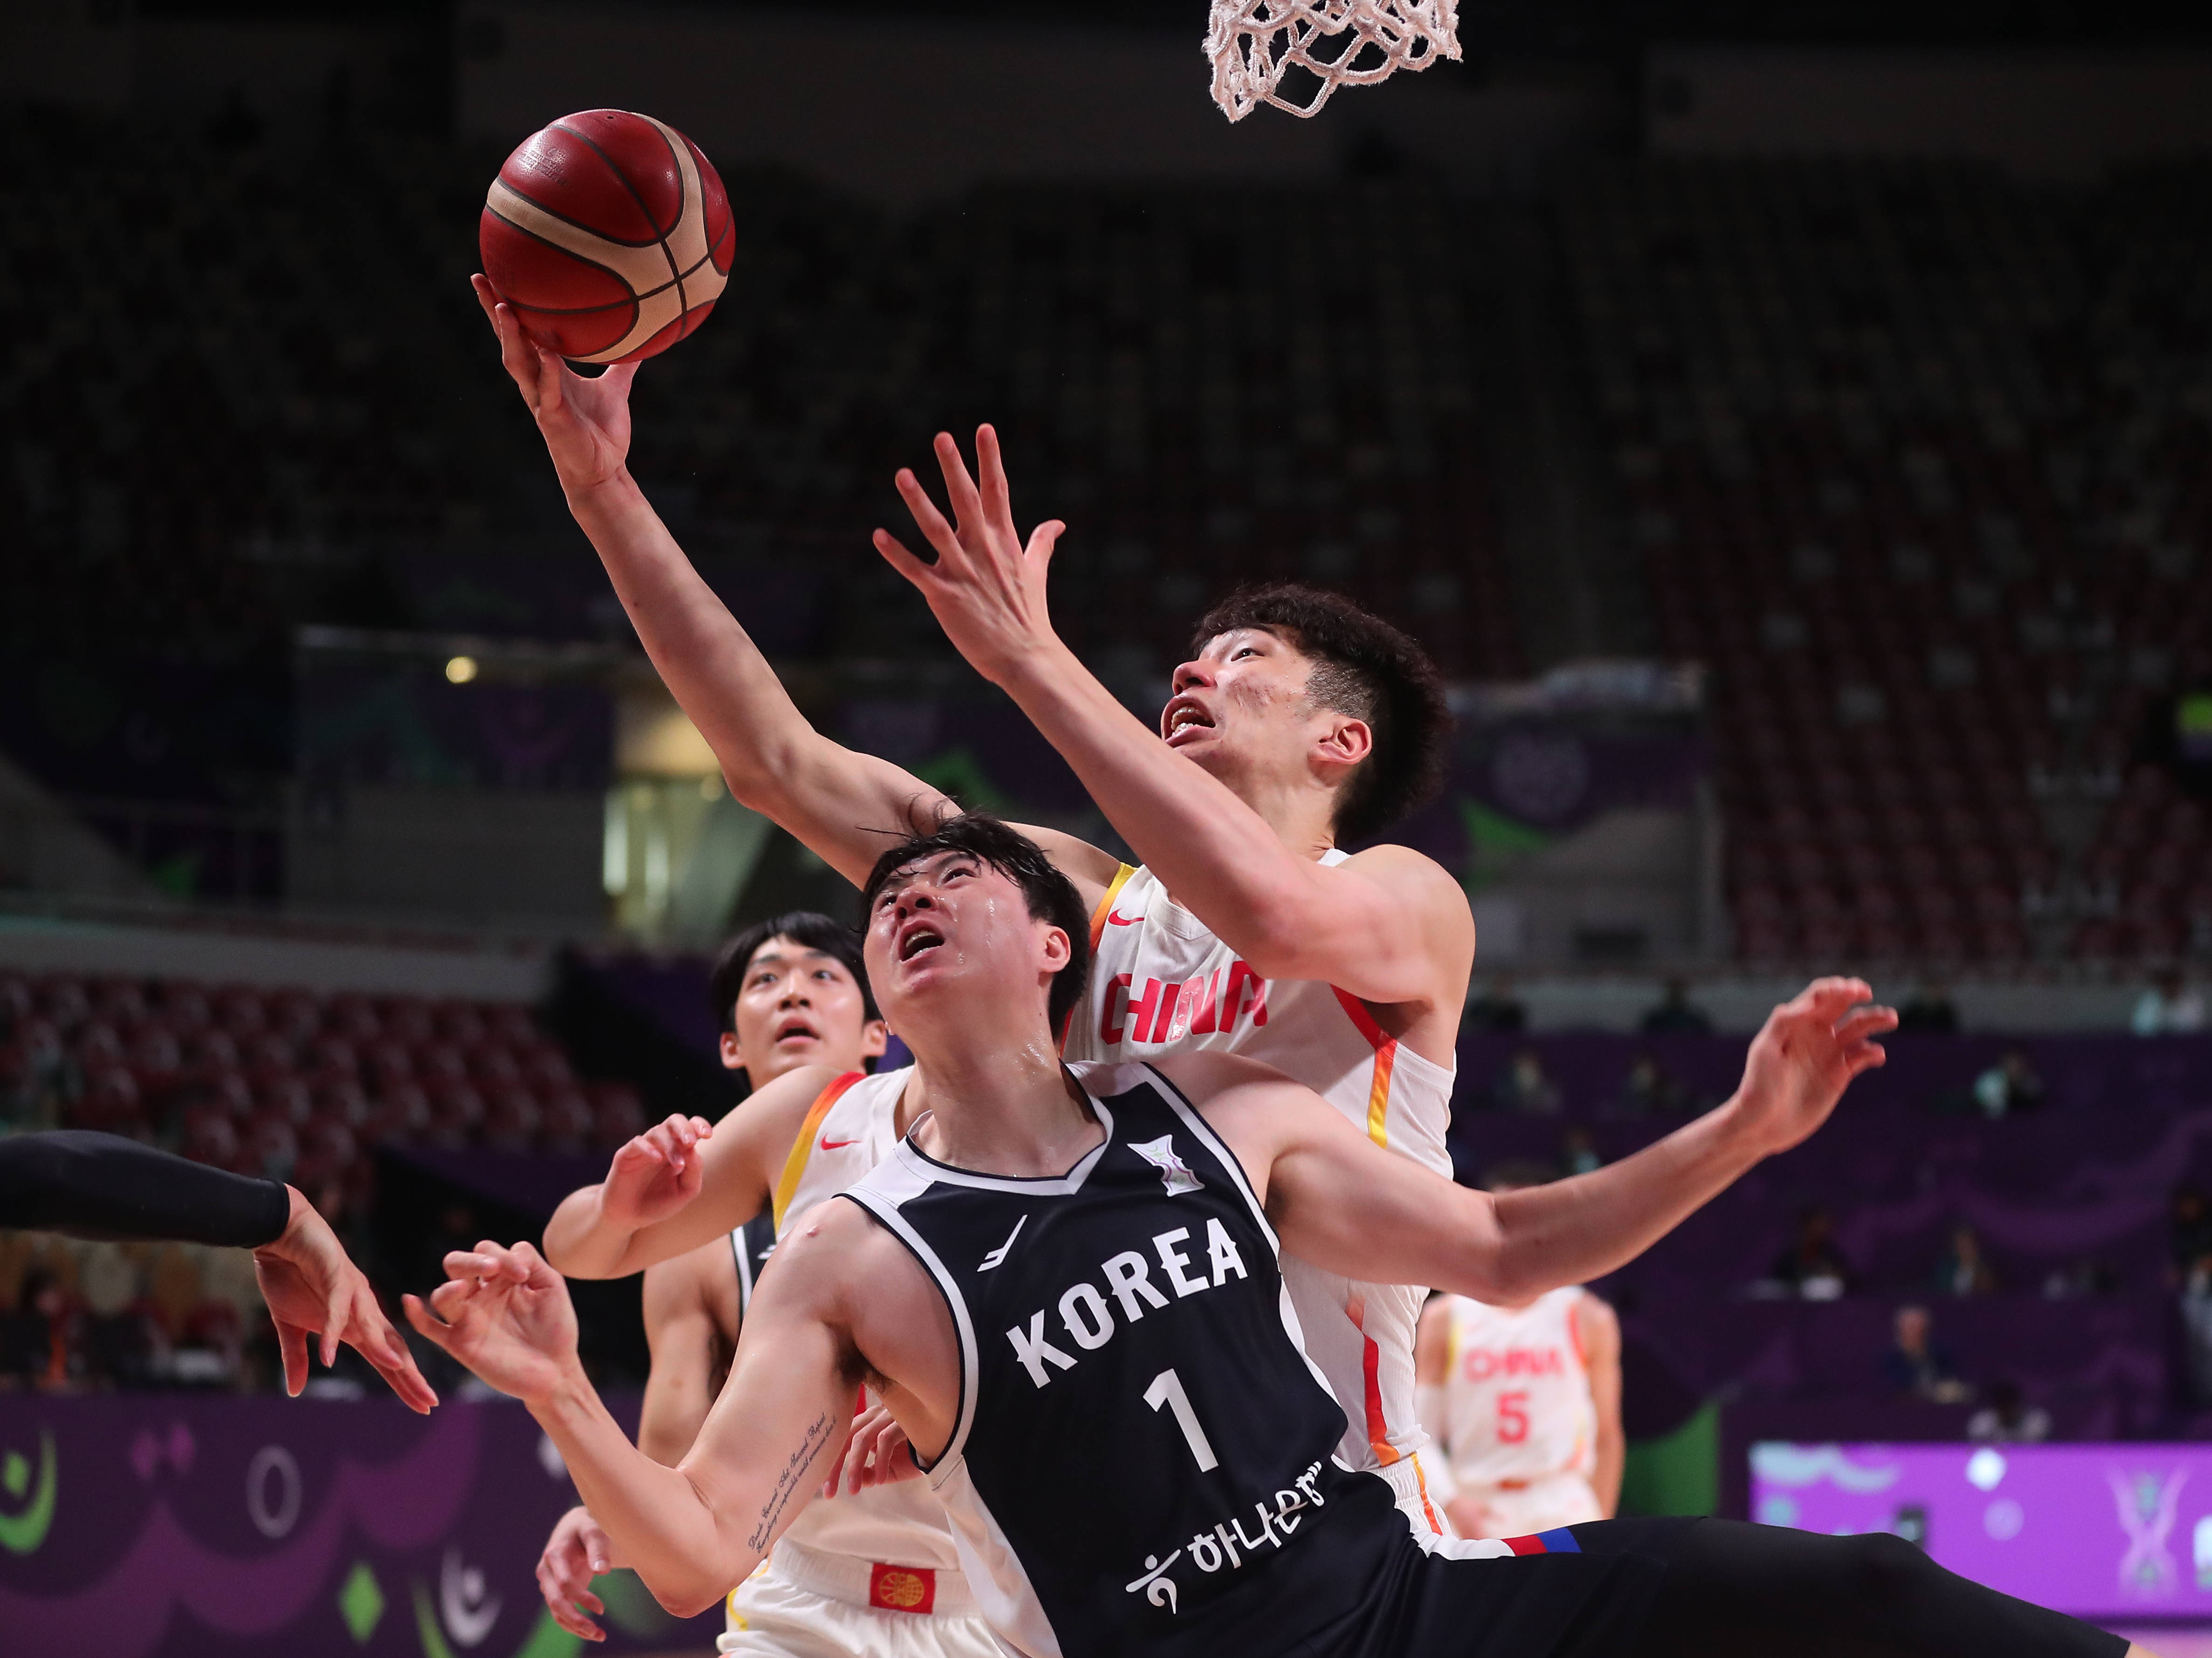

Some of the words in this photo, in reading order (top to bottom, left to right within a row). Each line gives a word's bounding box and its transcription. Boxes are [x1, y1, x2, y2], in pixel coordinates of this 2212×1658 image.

[1101, 961, 1268, 1044] CHINA
[1006, 1217, 1248, 1389] KOREA
[1143, 1368, 1218, 1472] 1
[1497, 1392, 1529, 1444] 5
